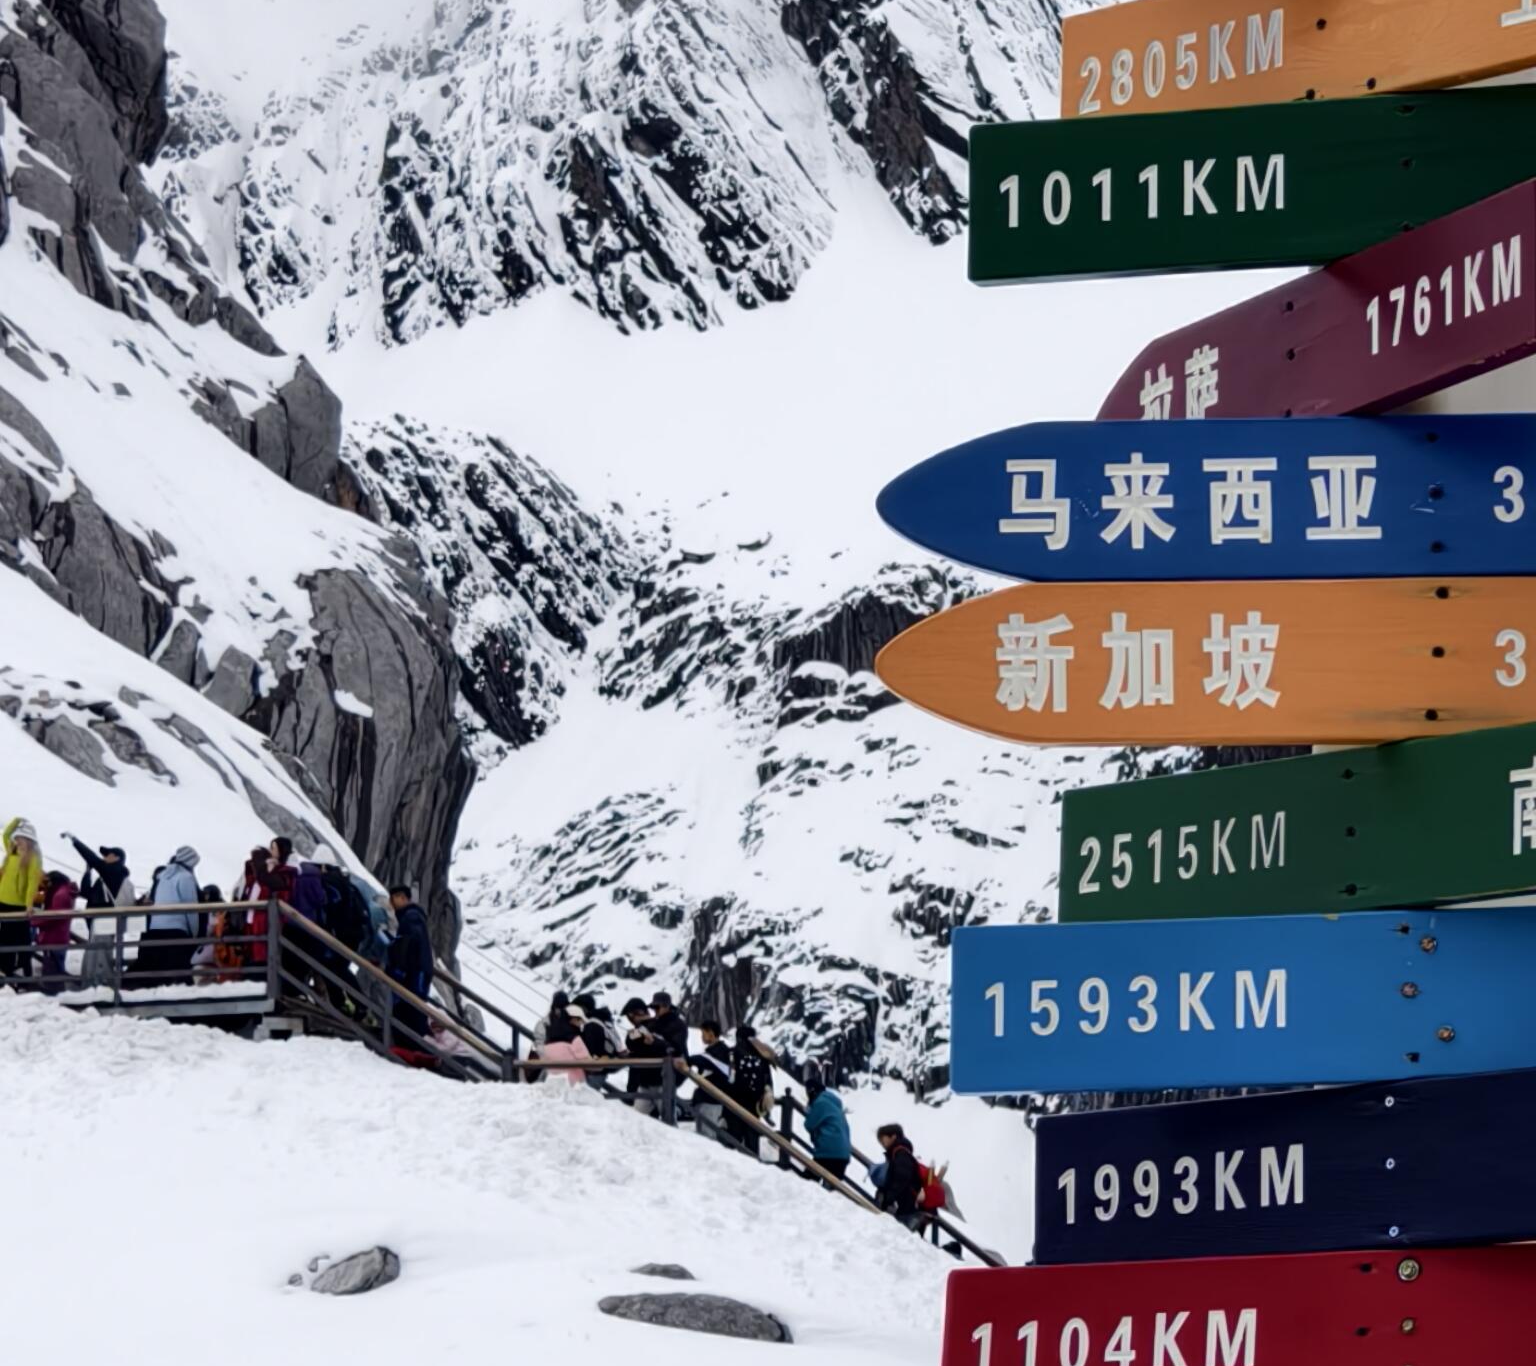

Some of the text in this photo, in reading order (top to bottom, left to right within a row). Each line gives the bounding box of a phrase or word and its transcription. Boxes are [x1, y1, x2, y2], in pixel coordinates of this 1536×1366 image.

[1079, 8, 1284, 115] 2805KM
[1000, 154, 1284, 227] 1011KM
[1365, 236, 1522, 356] 1761KM
[999, 453, 1382, 550] 马来西亚
[996, 611, 1280, 712] 新加坡
[1079, 811, 1285, 894] 2515KM
[986, 969, 1286, 1036] 1593KM
[1059, 1144, 1303, 1224] 1993KM
